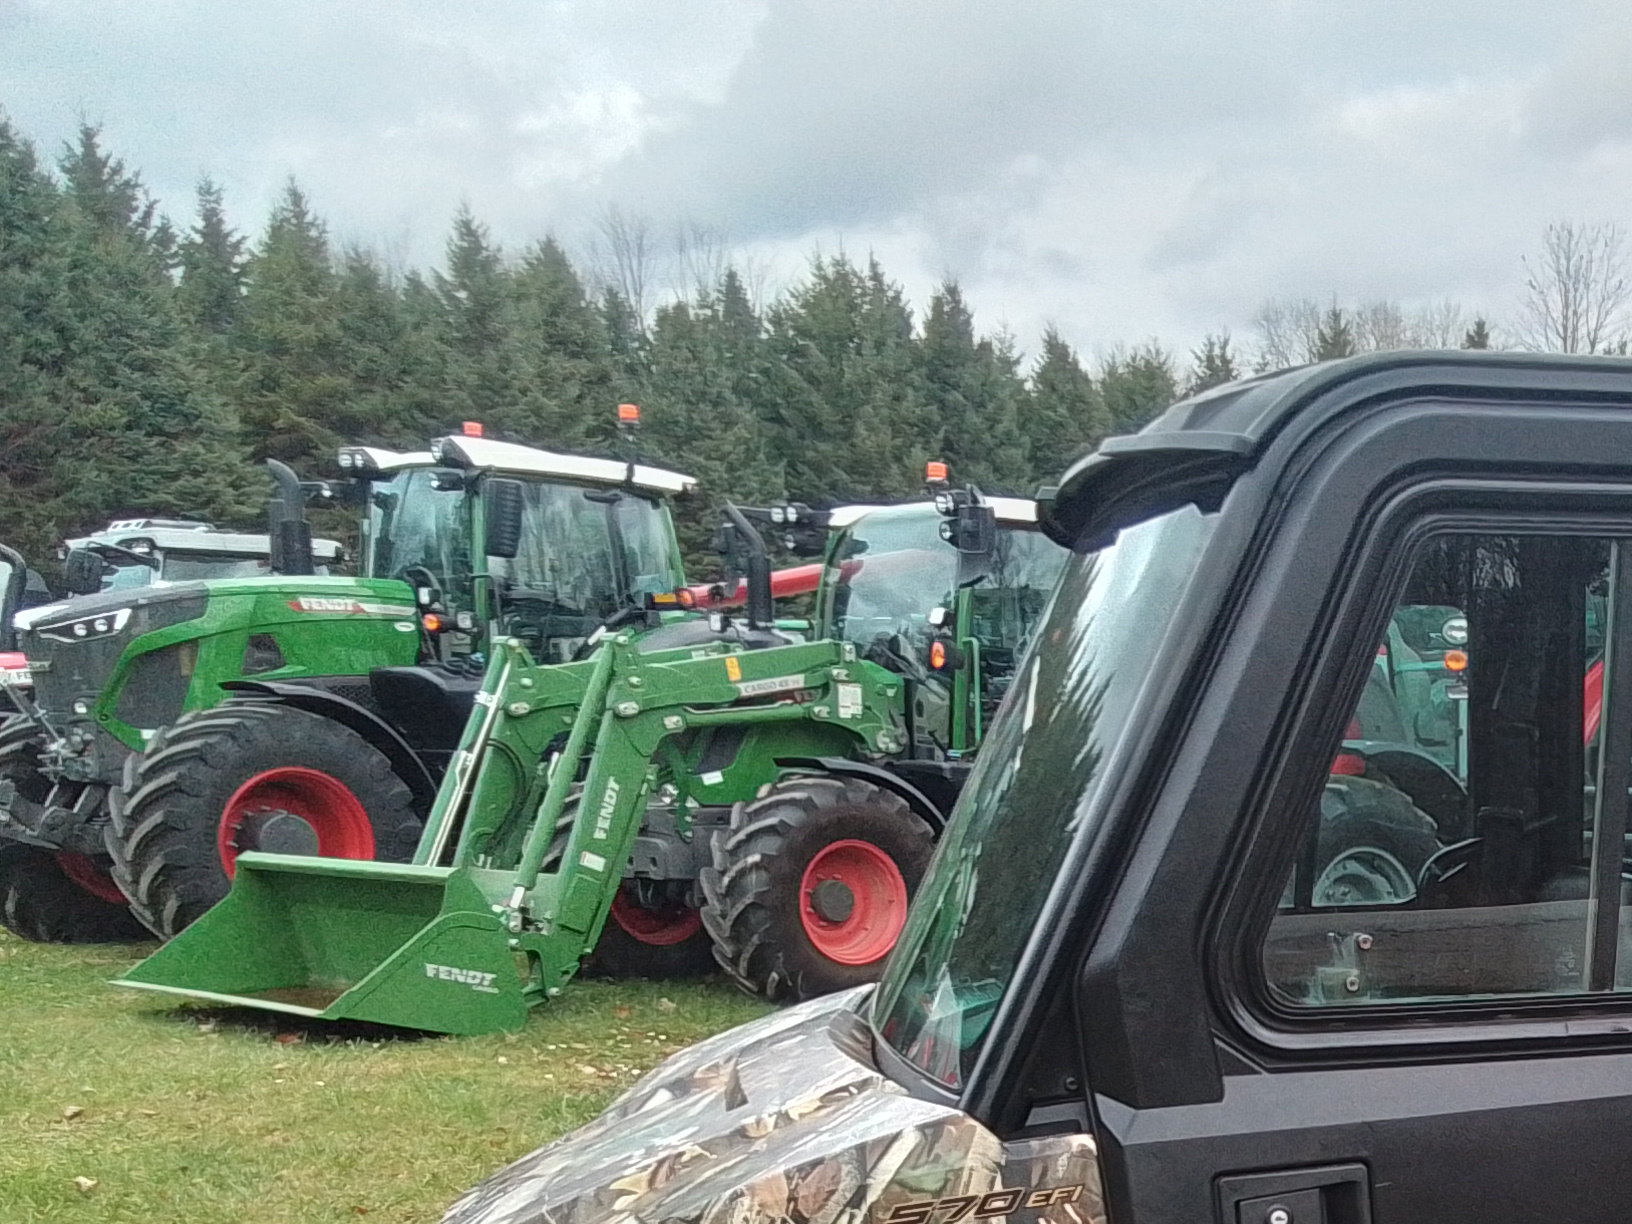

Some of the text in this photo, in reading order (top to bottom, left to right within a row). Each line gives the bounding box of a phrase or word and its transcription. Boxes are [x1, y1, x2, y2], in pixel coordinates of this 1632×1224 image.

[299, 597, 358, 611] FENDT
[744, 681, 777, 694] CARGO
[593, 775, 620, 840] FENDT
[424, 963, 498, 986] FENDT
[1024, 1183, 1086, 1209] EFI
